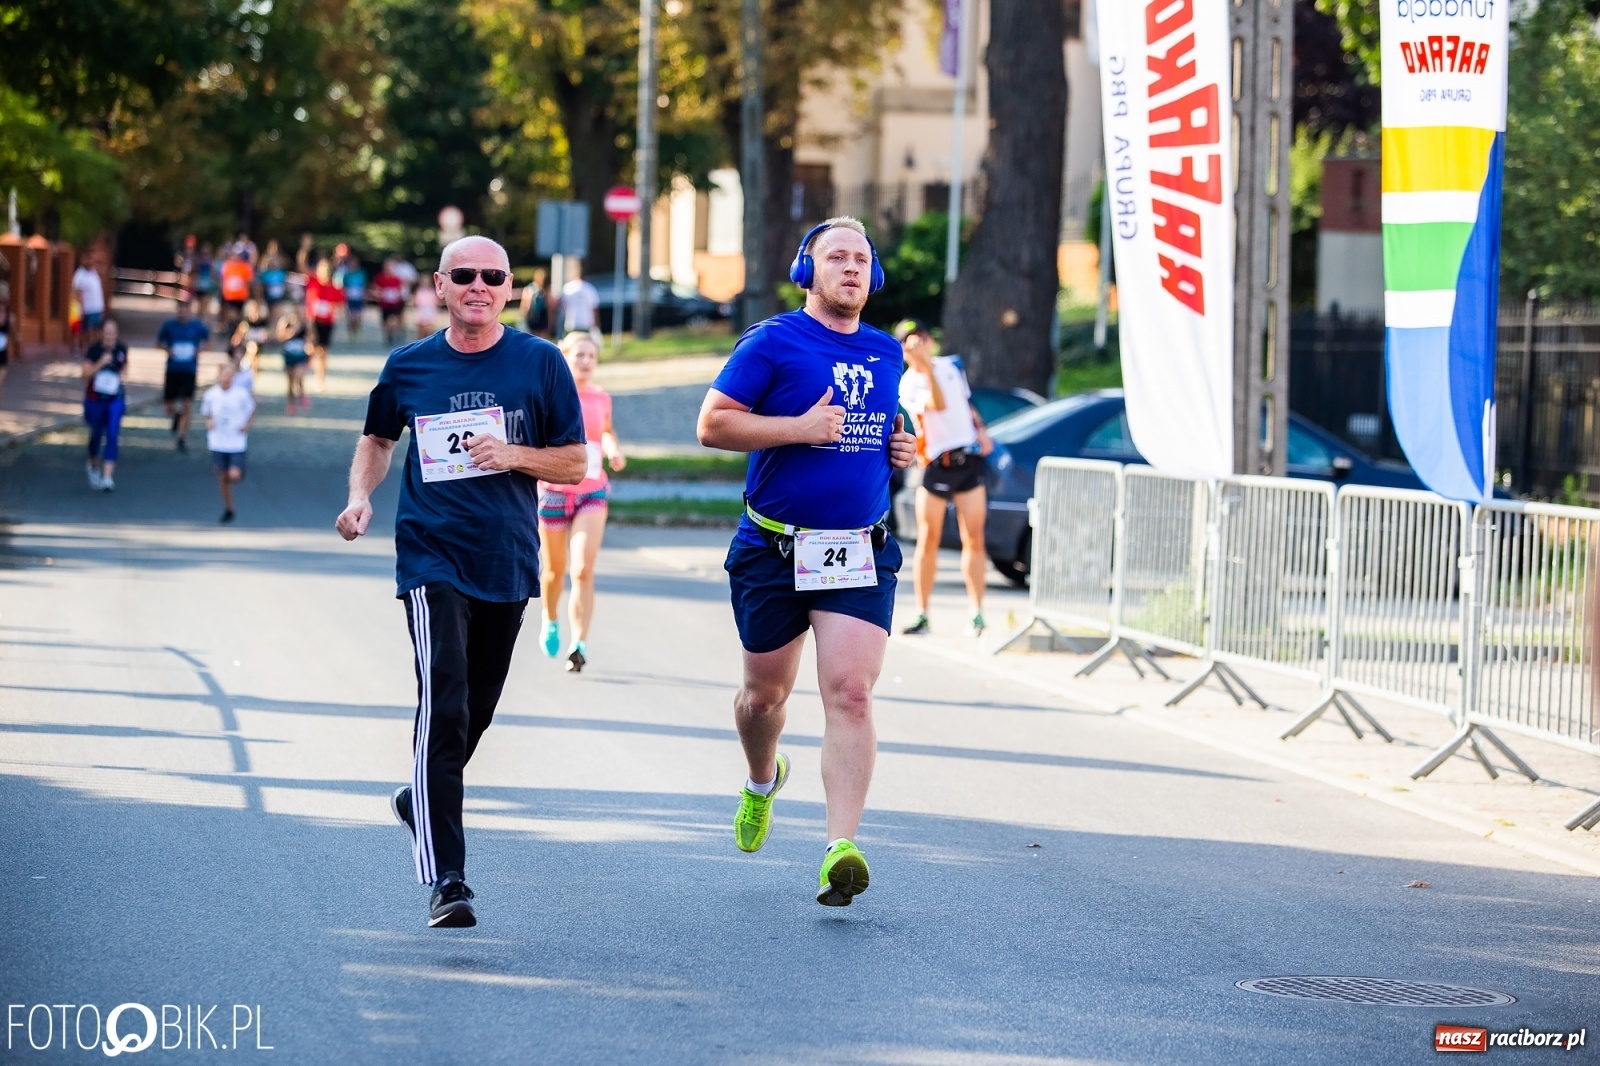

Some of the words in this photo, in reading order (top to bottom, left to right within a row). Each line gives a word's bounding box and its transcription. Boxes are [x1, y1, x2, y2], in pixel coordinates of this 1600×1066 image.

[449, 391, 496, 413] NIKE
[868, 412, 886, 424] AIR
[842, 424, 883, 437] OWICE
[839, 437, 882, 446] MARATHON
[839, 445, 860, 453] 2019
[823, 547, 848, 567] 24
